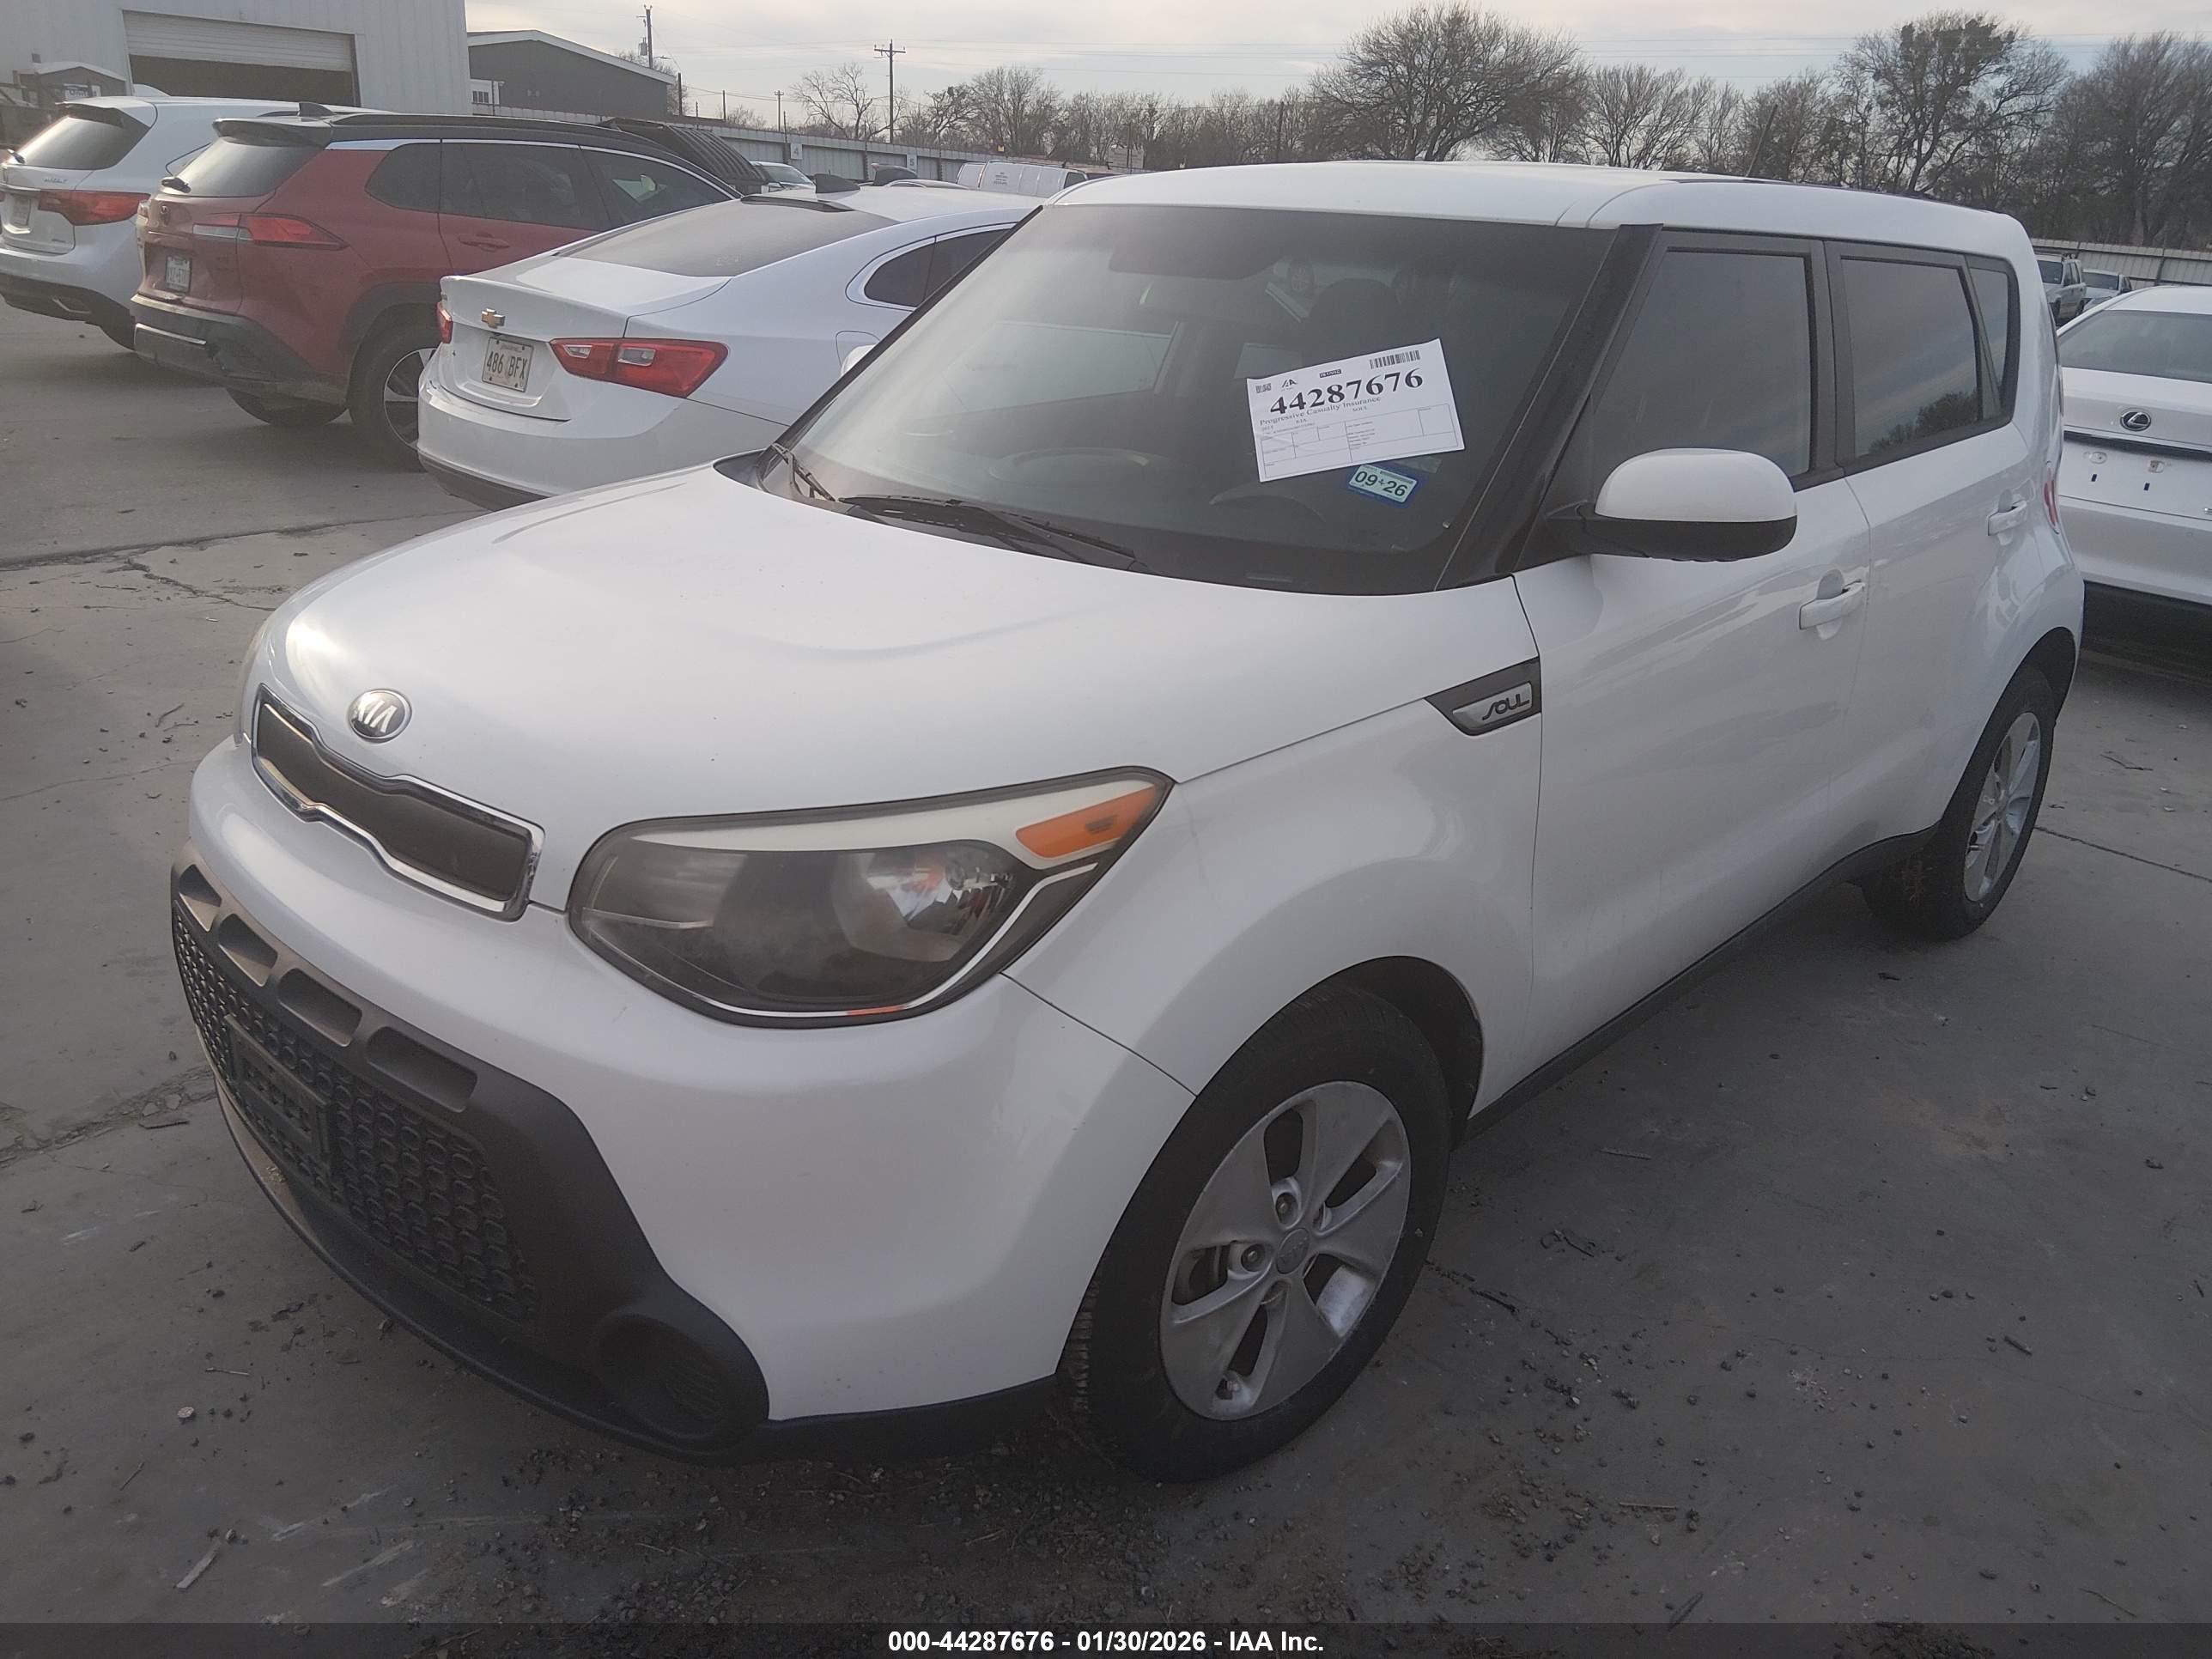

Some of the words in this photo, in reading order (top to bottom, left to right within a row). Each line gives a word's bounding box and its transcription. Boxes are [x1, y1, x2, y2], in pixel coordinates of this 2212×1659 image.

[487, 350, 504, 374] 486
[508, 356, 528, 380] BFX
[1270, 368, 1424, 414] 44287676
[1260, 412, 1304, 427] Progressive
[1306, 404, 1340, 416] Casualty
[1343, 397, 1382, 409] Insurance
[1355, 471, 1377, 486] 09
[1382, 480, 1408, 496] 26
[1482, 693, 1529, 720] SOUL
